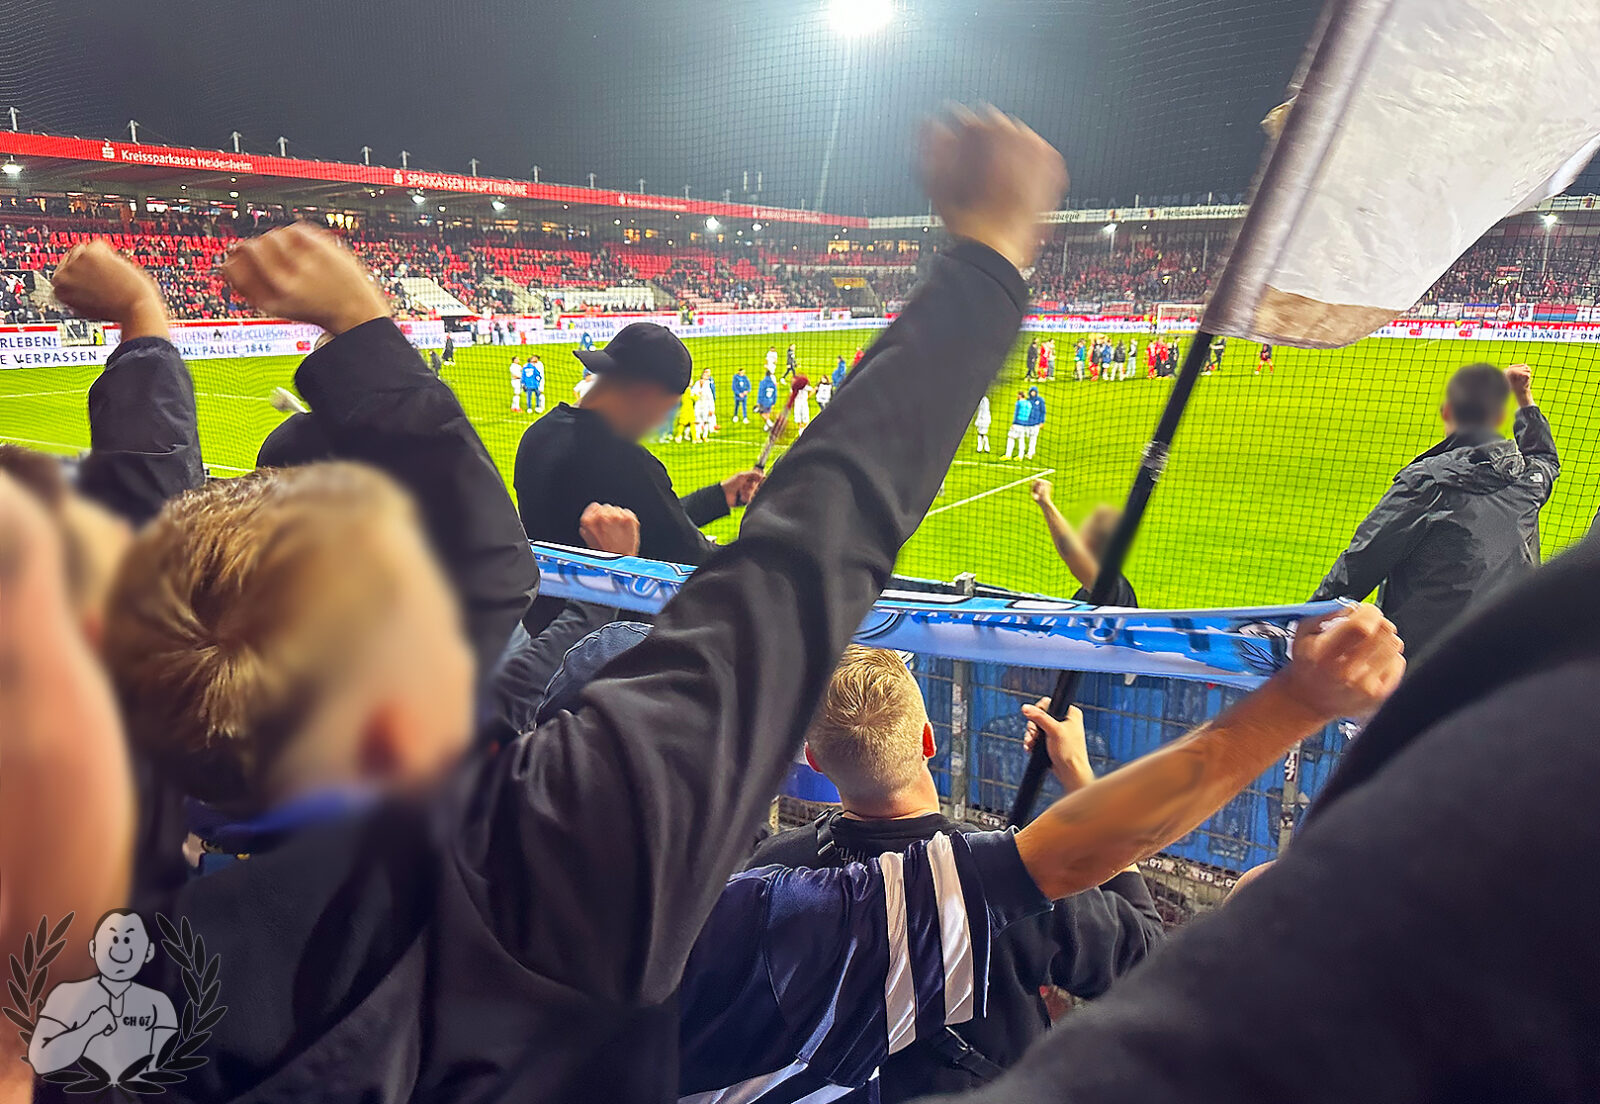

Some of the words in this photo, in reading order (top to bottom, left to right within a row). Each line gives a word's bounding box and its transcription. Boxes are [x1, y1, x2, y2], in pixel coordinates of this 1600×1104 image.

[121, 149, 196, 167] Kreissparkasse
[197, 156, 253, 171] Heidenheim
[14, 350, 97, 365] VERPASSEN
